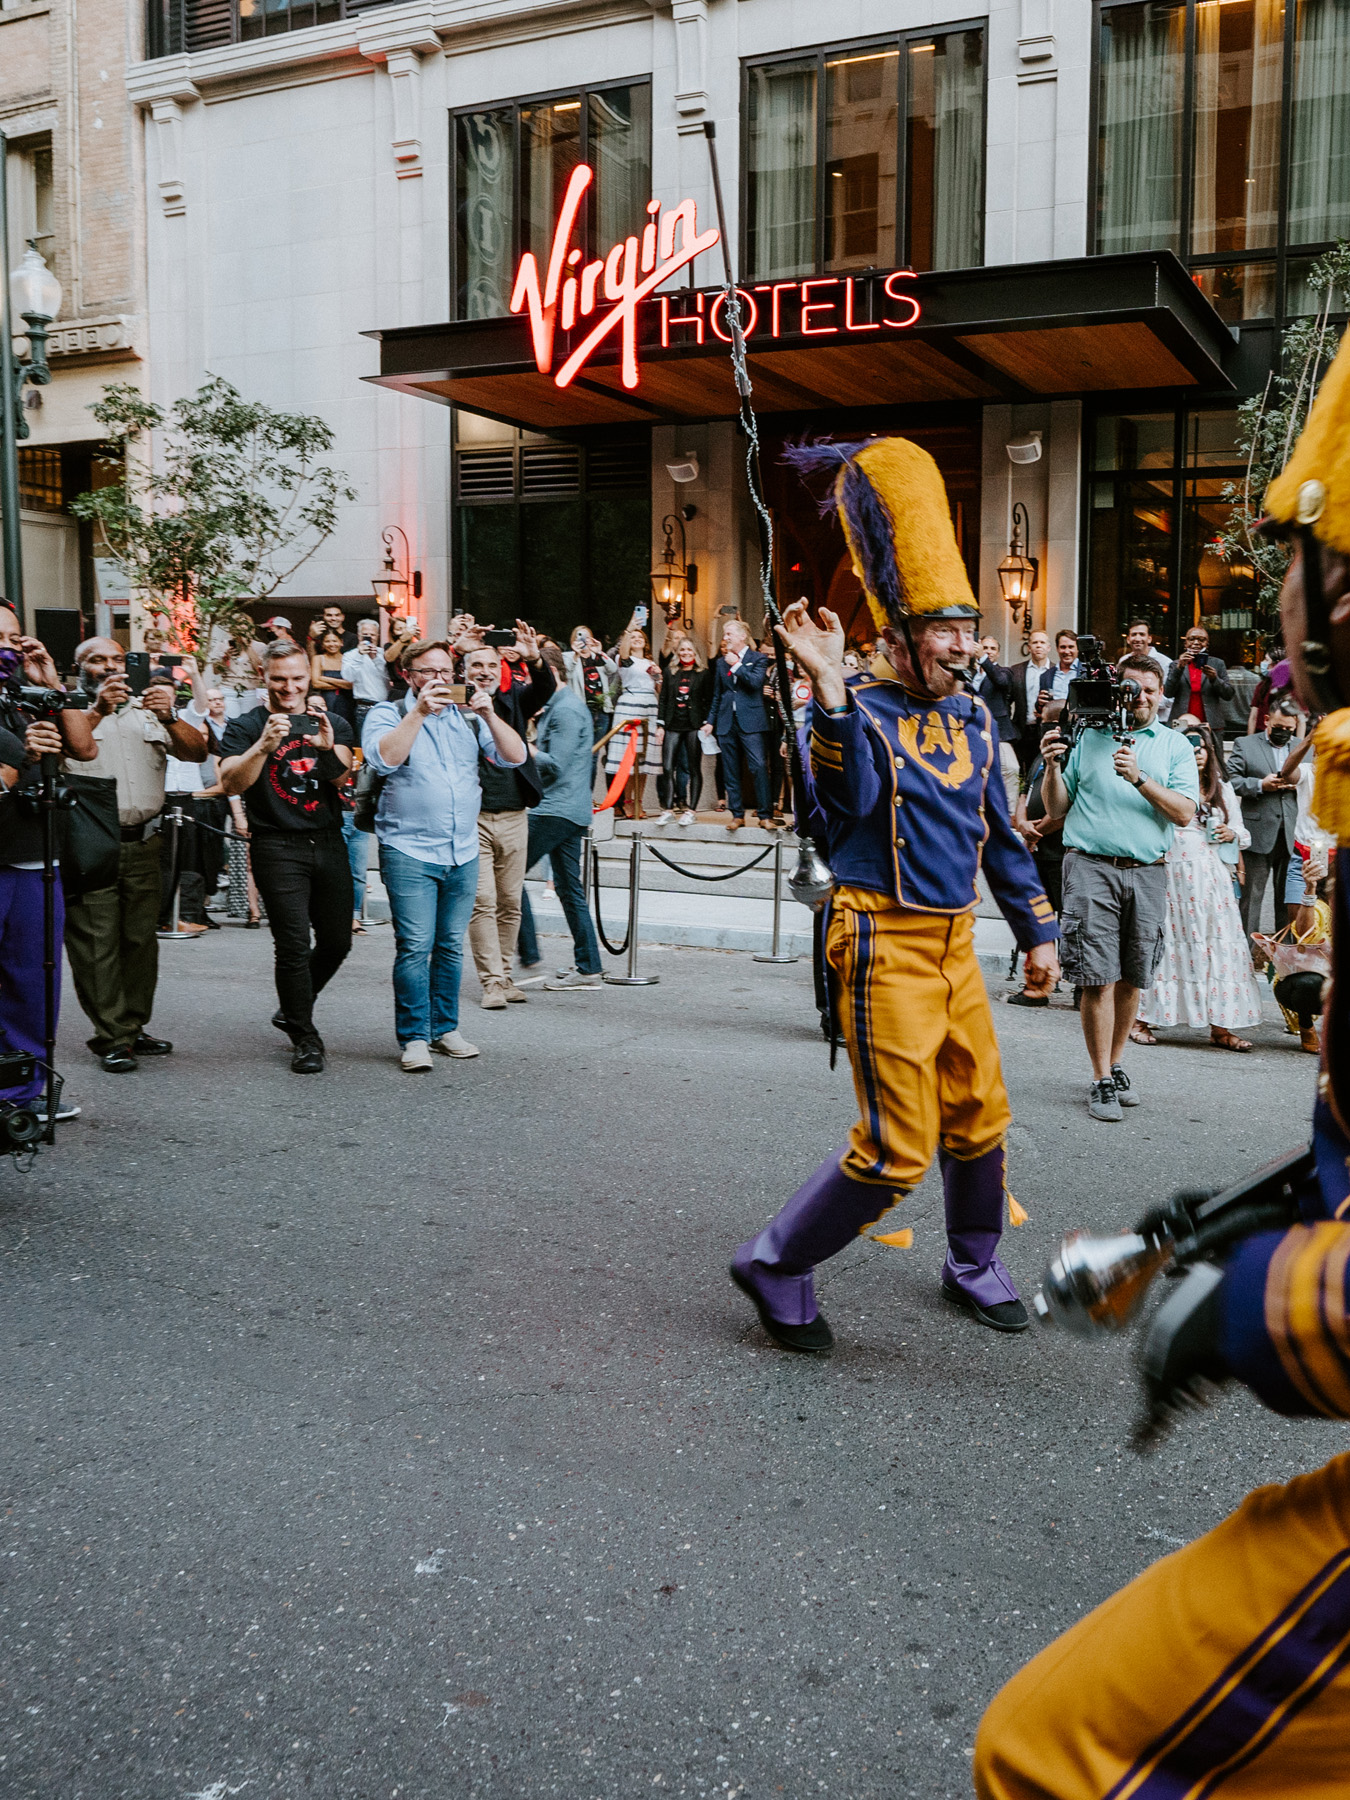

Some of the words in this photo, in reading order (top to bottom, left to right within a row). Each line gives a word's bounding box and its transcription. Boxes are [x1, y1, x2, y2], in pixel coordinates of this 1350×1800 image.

[510, 164, 720, 388] Virgin
[661, 270, 921, 348] HOTELS
[273, 739, 301, 760] LEAVES
[920, 710, 954, 756] A
[269, 764, 298, 804] EVERYONE
